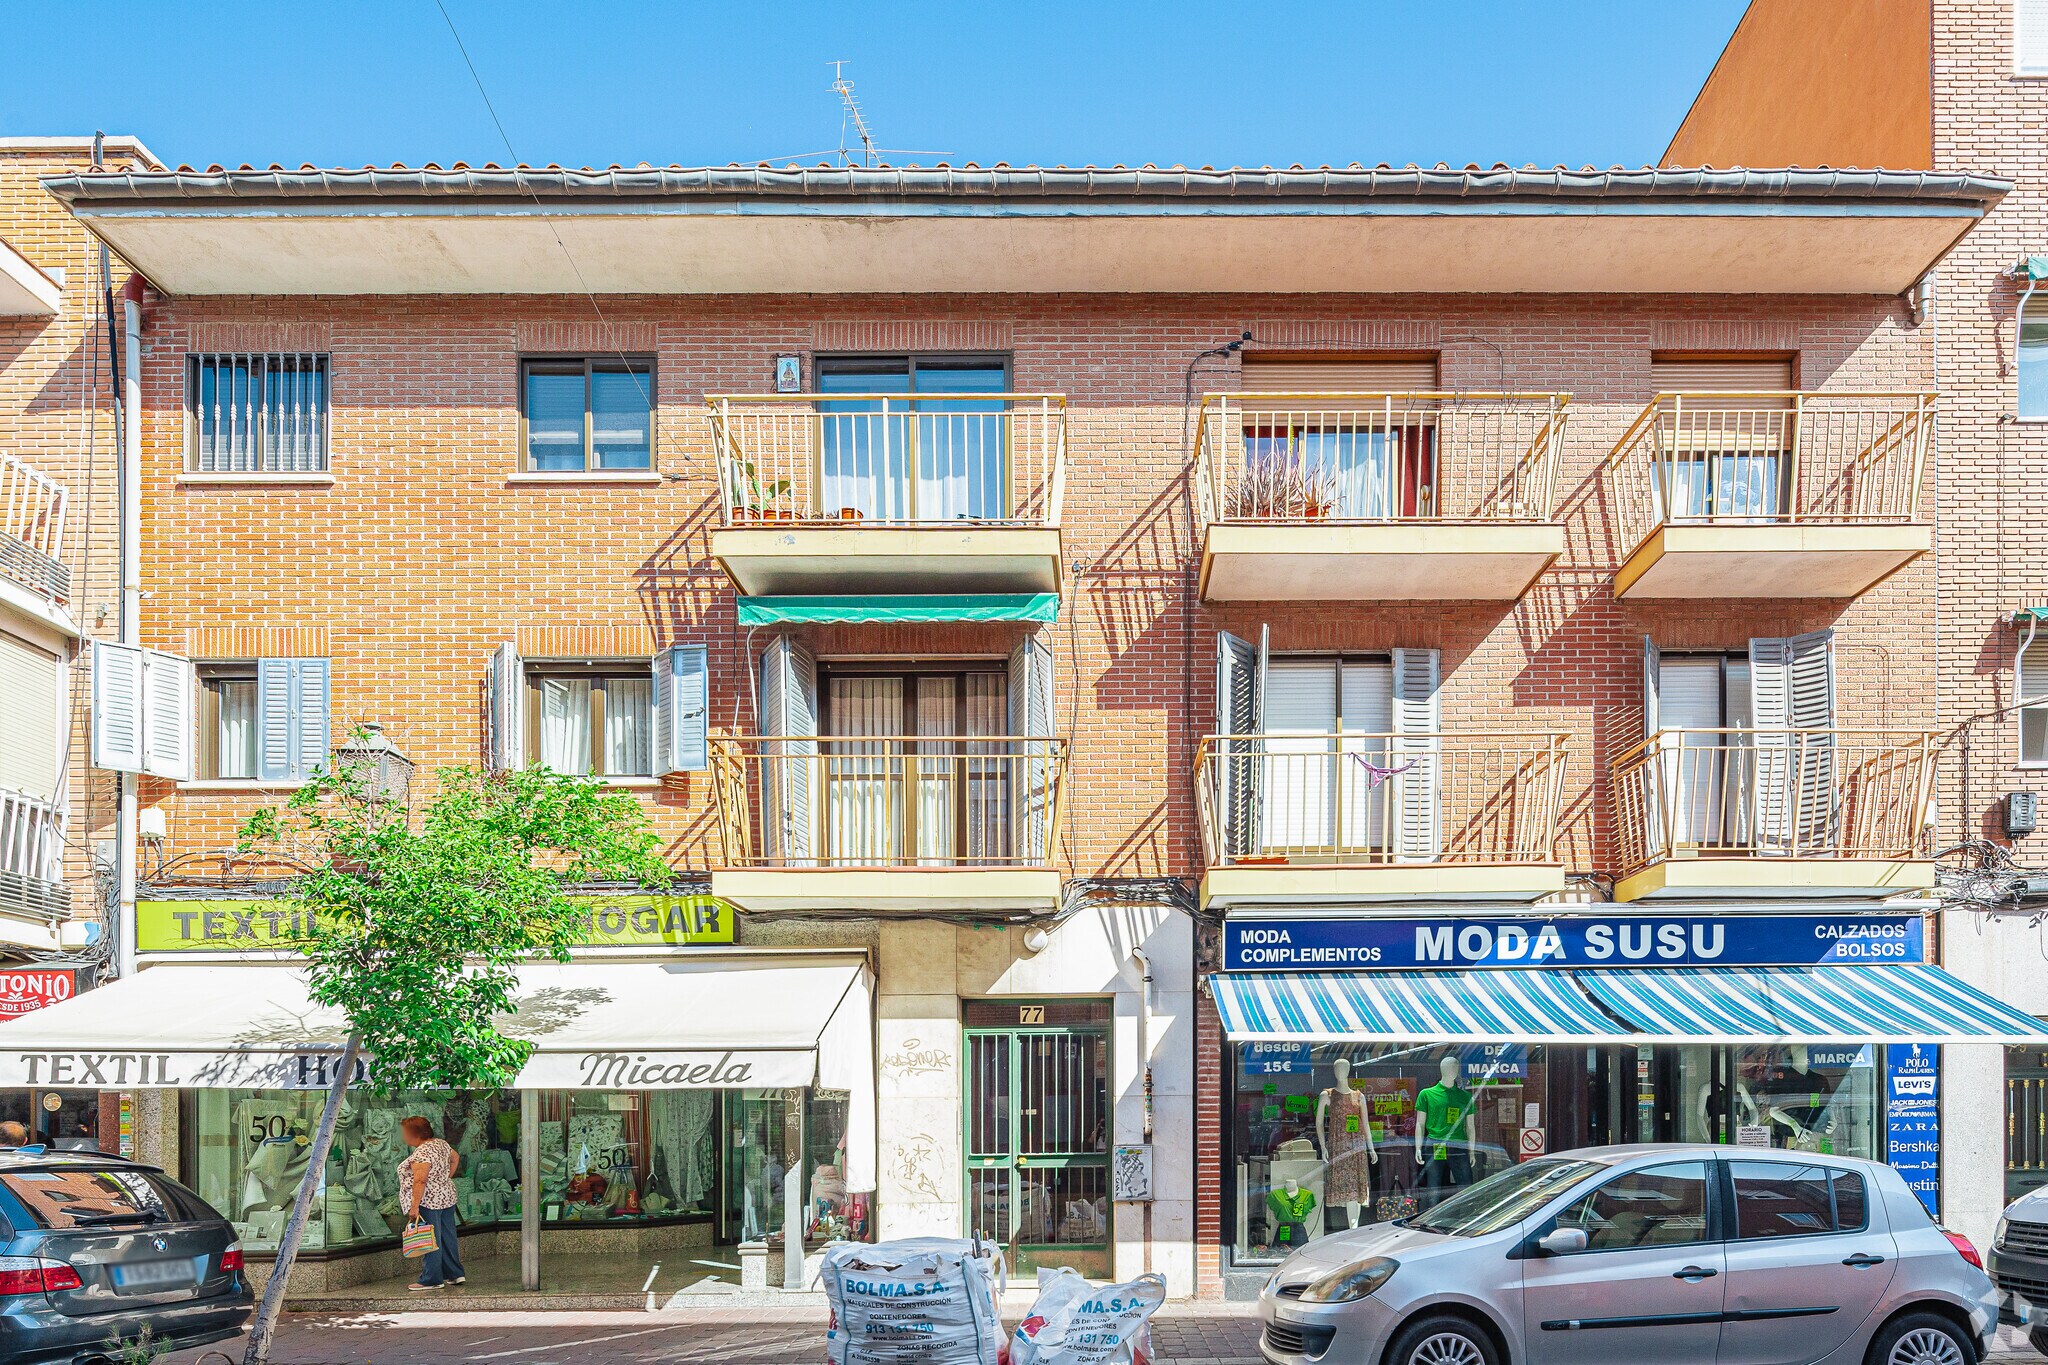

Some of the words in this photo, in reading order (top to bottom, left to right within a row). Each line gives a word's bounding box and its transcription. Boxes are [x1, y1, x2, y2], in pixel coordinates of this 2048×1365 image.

[1240, 929, 1292, 944] MODA
[1814, 924, 1906, 939] CALZADOS
[1414, 925, 1567, 961] MODA
[1583, 923, 1725, 960] SUSU
[1240, 947, 1382, 963] COMPLEMENTOS
[1836, 942, 1906, 957] BOLSOS
[20, 999, 42, 1012] 1935
[1021, 1007, 1044, 1023] 77
[1253, 1041, 1301, 1053] desde
[1814, 1052, 1866, 1064] MARCA
[1905, 1058, 1929, 1068] POLO
[20, 1053, 181, 1085] TEXTIL
[579, 1050, 753, 1089] Micaela
[1263, 1060, 1292, 1073] 15€
[1467, 1063, 1520, 1074] MARCA
[250, 1114, 287, 1143] 50
[1890, 1122, 1940, 1132] ZARA
[1889, 1140, 1940, 1153] Bershka
[597, 1148, 627, 1170] 50
[1906, 1178, 1940, 1191] ustin
[845, 1278, 950, 1298] BOLMA.S.A.
[847, 1299, 884, 1310] MATERIALES
[869, 1313, 927, 1321] CONTENEDORES
[865, 1323, 886, 1335] 913
[889, 1324, 909, 1335] 131
[912, 1322, 934, 1333] 750
[921, 1340, 958, 1351] RECOGIDA
[1079, 1333, 1098, 1344] 131
[1100, 1334, 1119, 1345] 750
[1076, 1355, 1101, 1363] ZONAS
